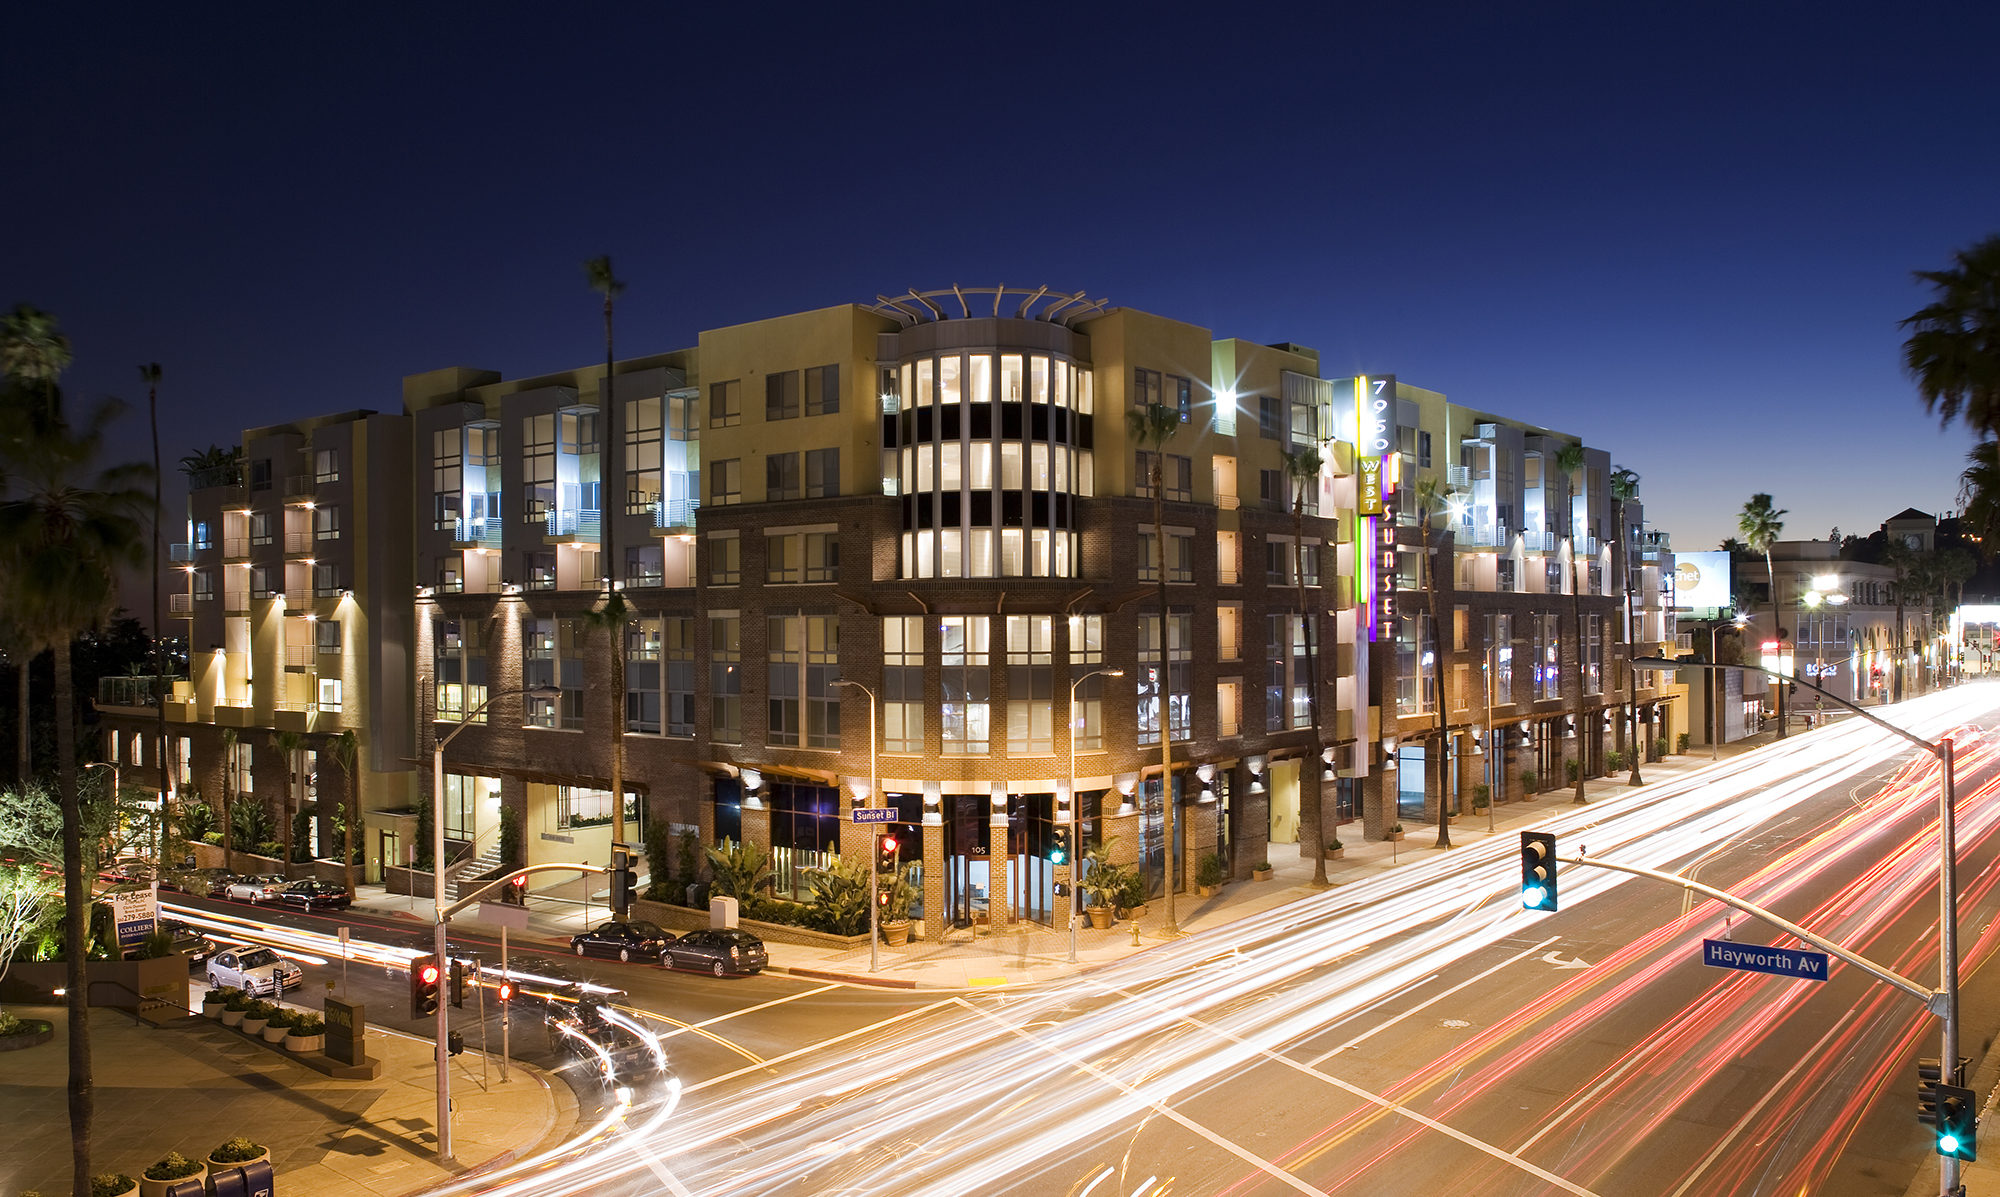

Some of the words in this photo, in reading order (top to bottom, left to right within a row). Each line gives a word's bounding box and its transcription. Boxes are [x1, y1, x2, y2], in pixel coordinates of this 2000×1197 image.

[1372, 380, 1389, 450] 7950
[1361, 460, 1380, 511] WEST
[856, 811, 884, 820] Sunset
[886, 811, 895, 819] Bl
[971, 846, 986, 854] 105
[131, 891, 152, 899] Lease
[123, 911, 155, 921] 279-5880
[120, 924, 153, 933] COLLIERS
[1711, 945, 1792, 969] Hayworth
[1798, 957, 1820, 972] Av
